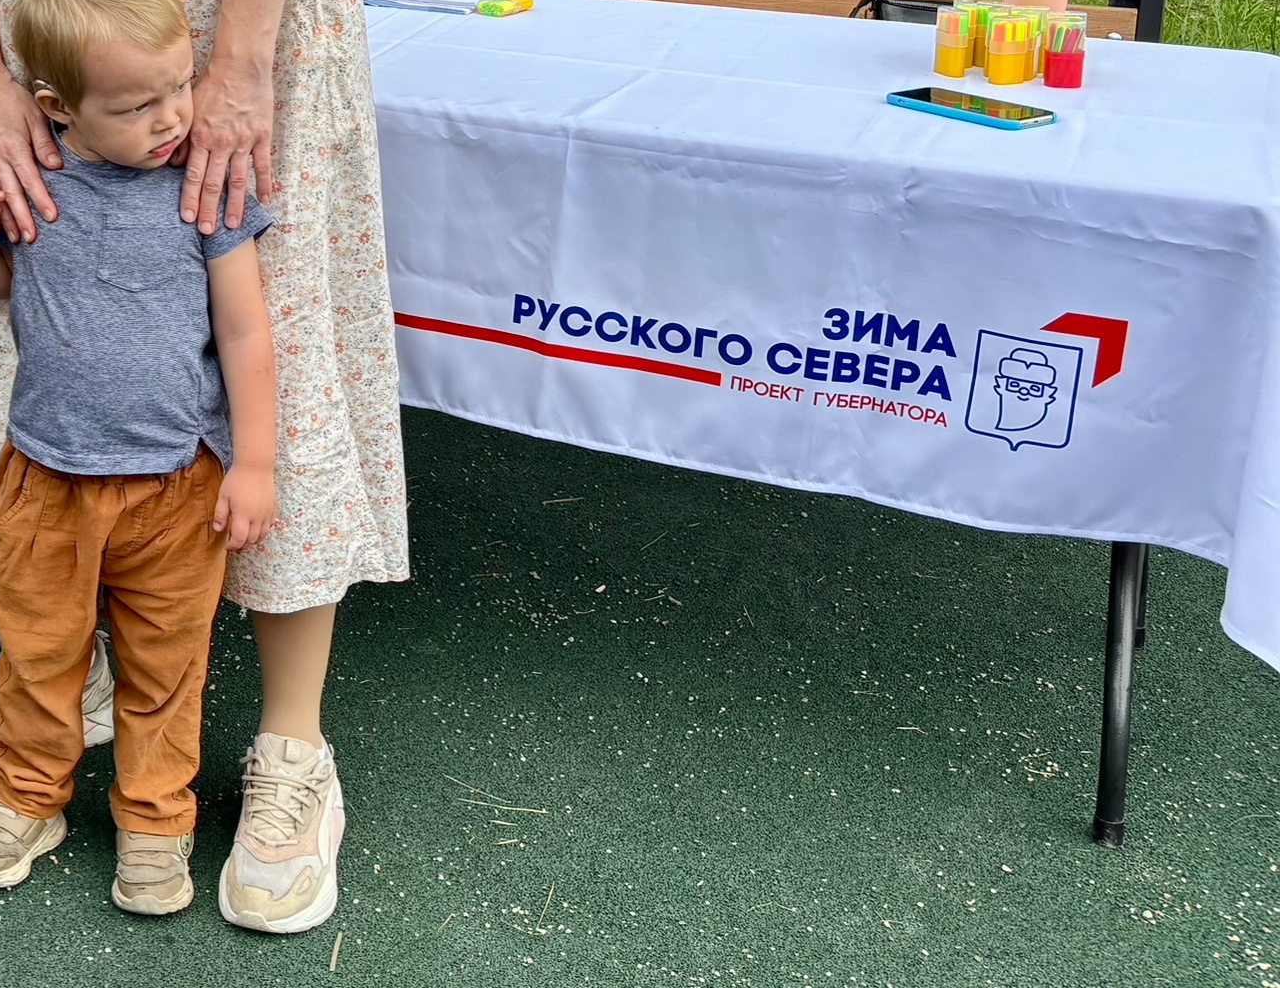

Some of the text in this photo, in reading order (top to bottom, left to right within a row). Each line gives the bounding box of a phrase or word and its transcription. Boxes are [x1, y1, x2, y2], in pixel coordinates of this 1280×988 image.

[511, 292, 954, 403] РУССКОГО СЕВЕРА
[822, 307, 958, 359] ЗИМА
[729, 374, 949, 429] ПРОЕКТ ГУБЕРНАТОРА
